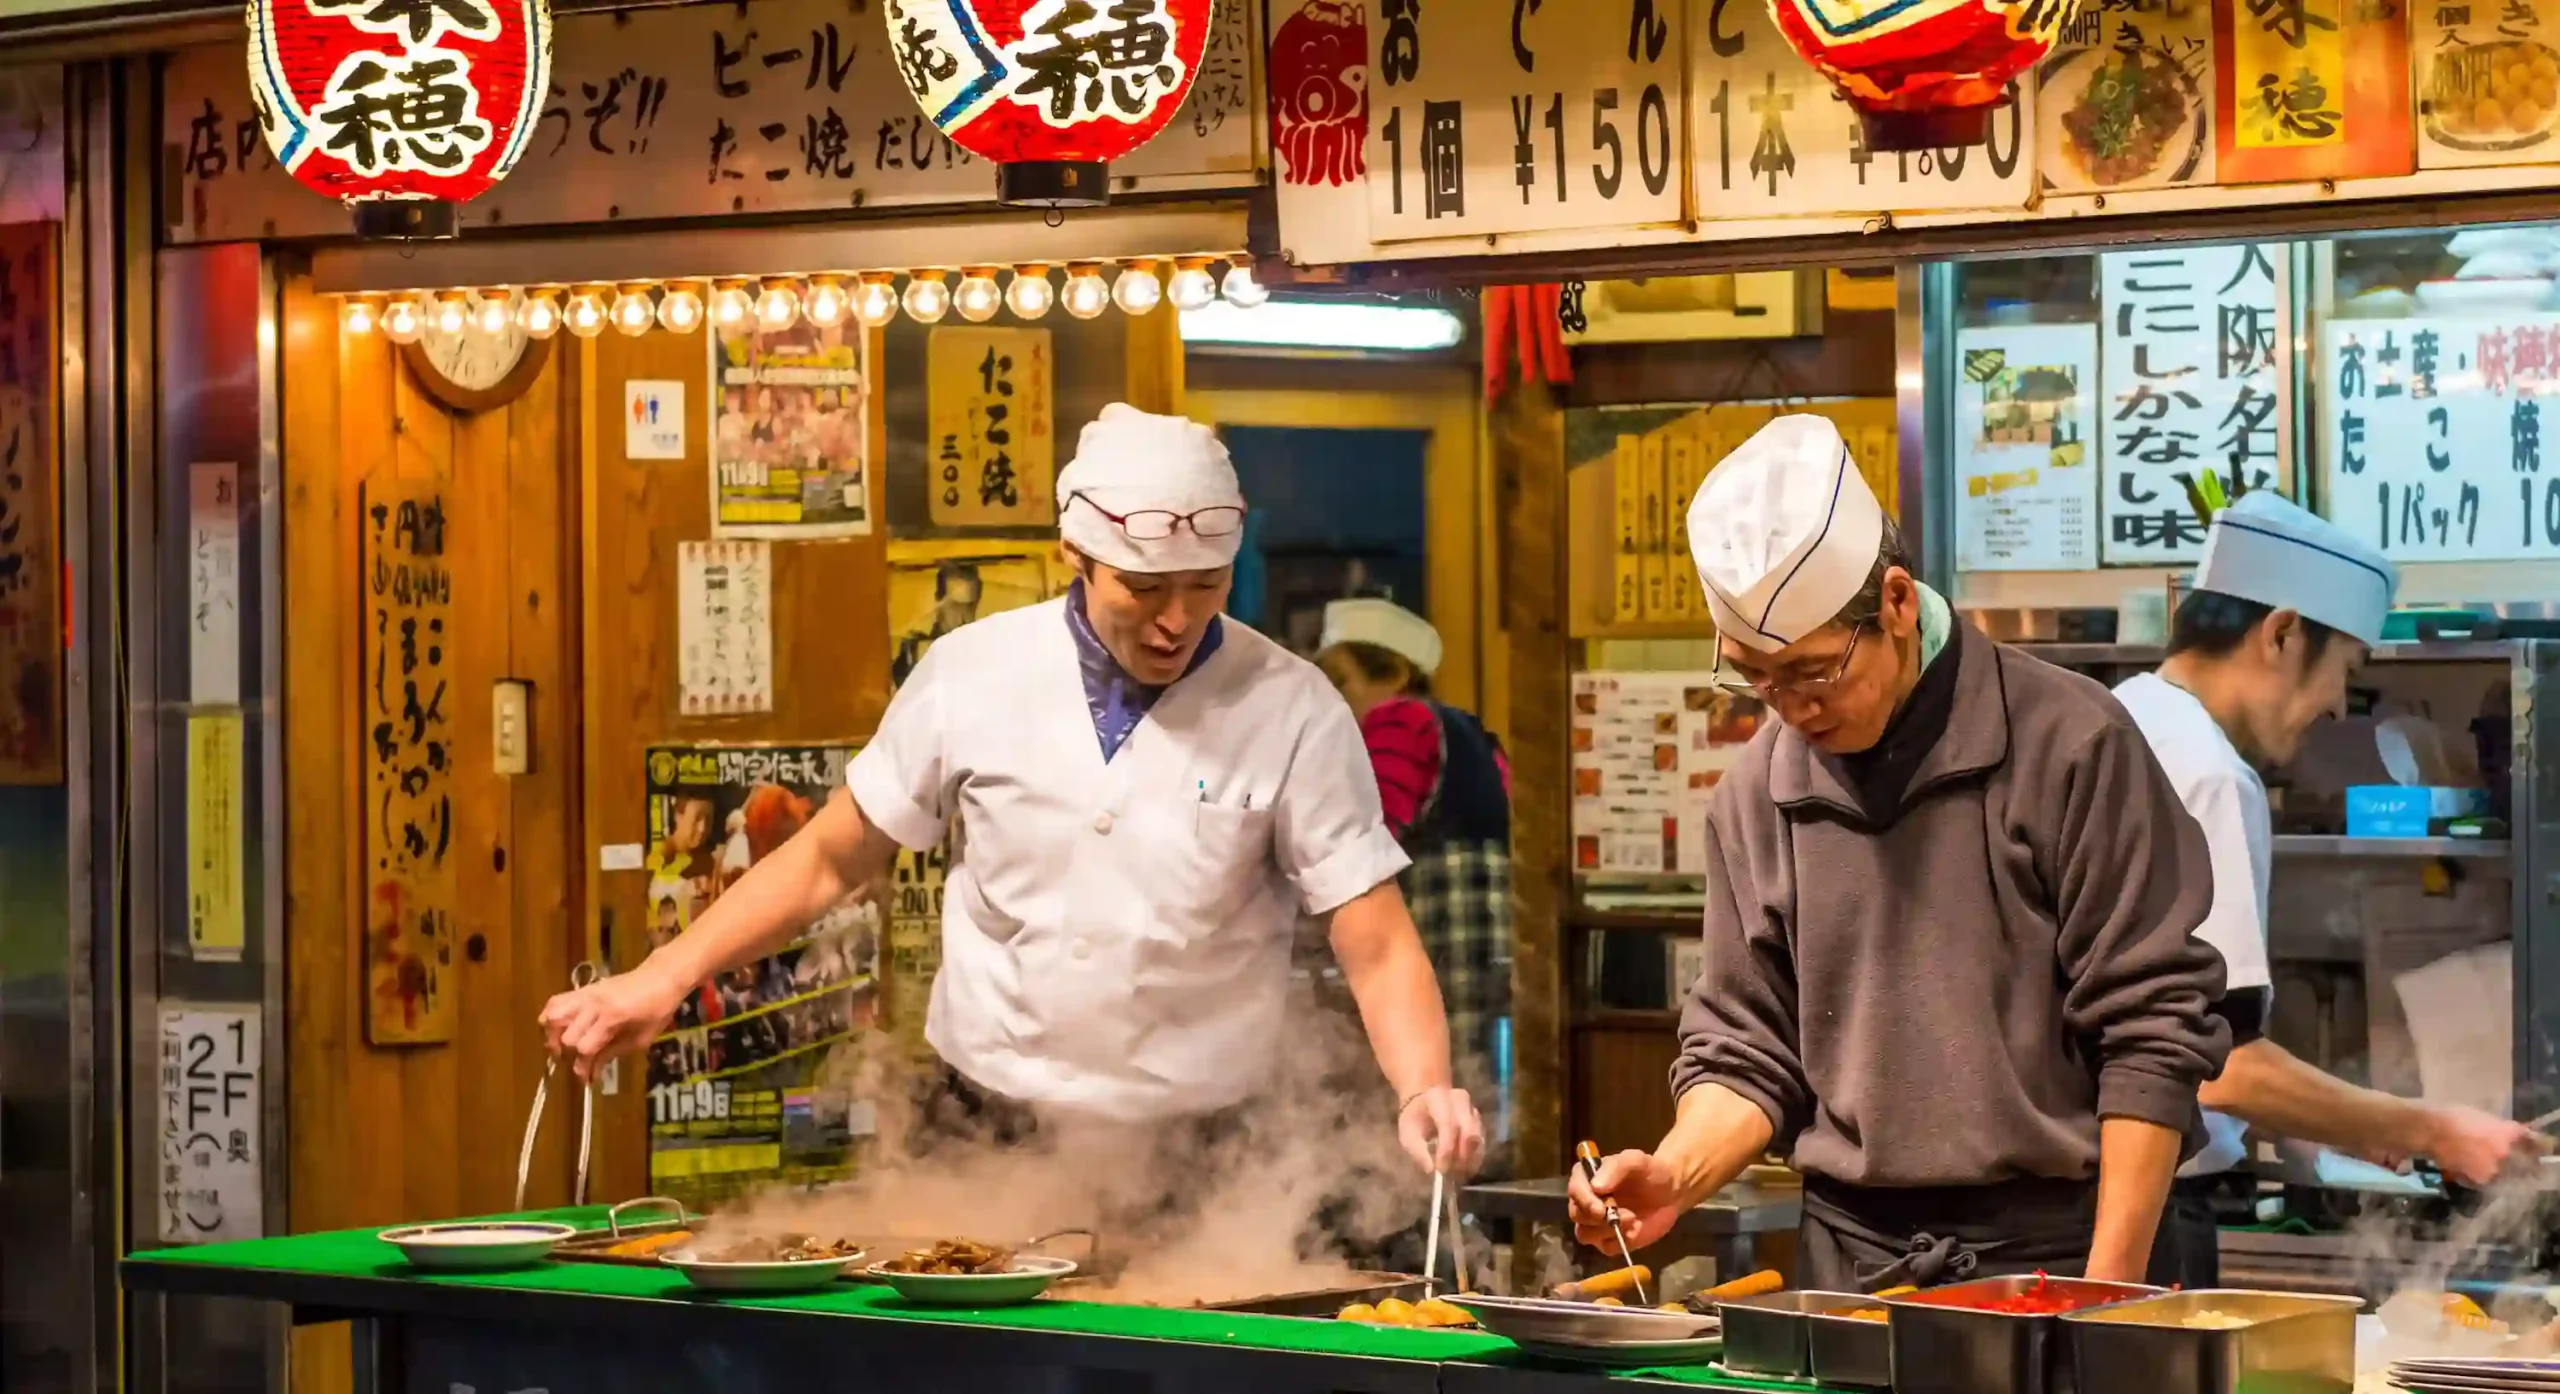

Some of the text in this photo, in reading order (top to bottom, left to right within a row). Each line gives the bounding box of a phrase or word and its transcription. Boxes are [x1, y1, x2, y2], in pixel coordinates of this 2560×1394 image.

[713, 24, 858, 97] ビール
[2433, 0, 2471, 48] 個入
[708, 106, 855, 183] たこ焼
[1382, 83, 1671, 220] 1個 ¥150
[1710, 72, 1796, 196] 1本
[2339, 399, 2541, 475] たこ焼
[2378, 481, 2480, 550] 1パック
